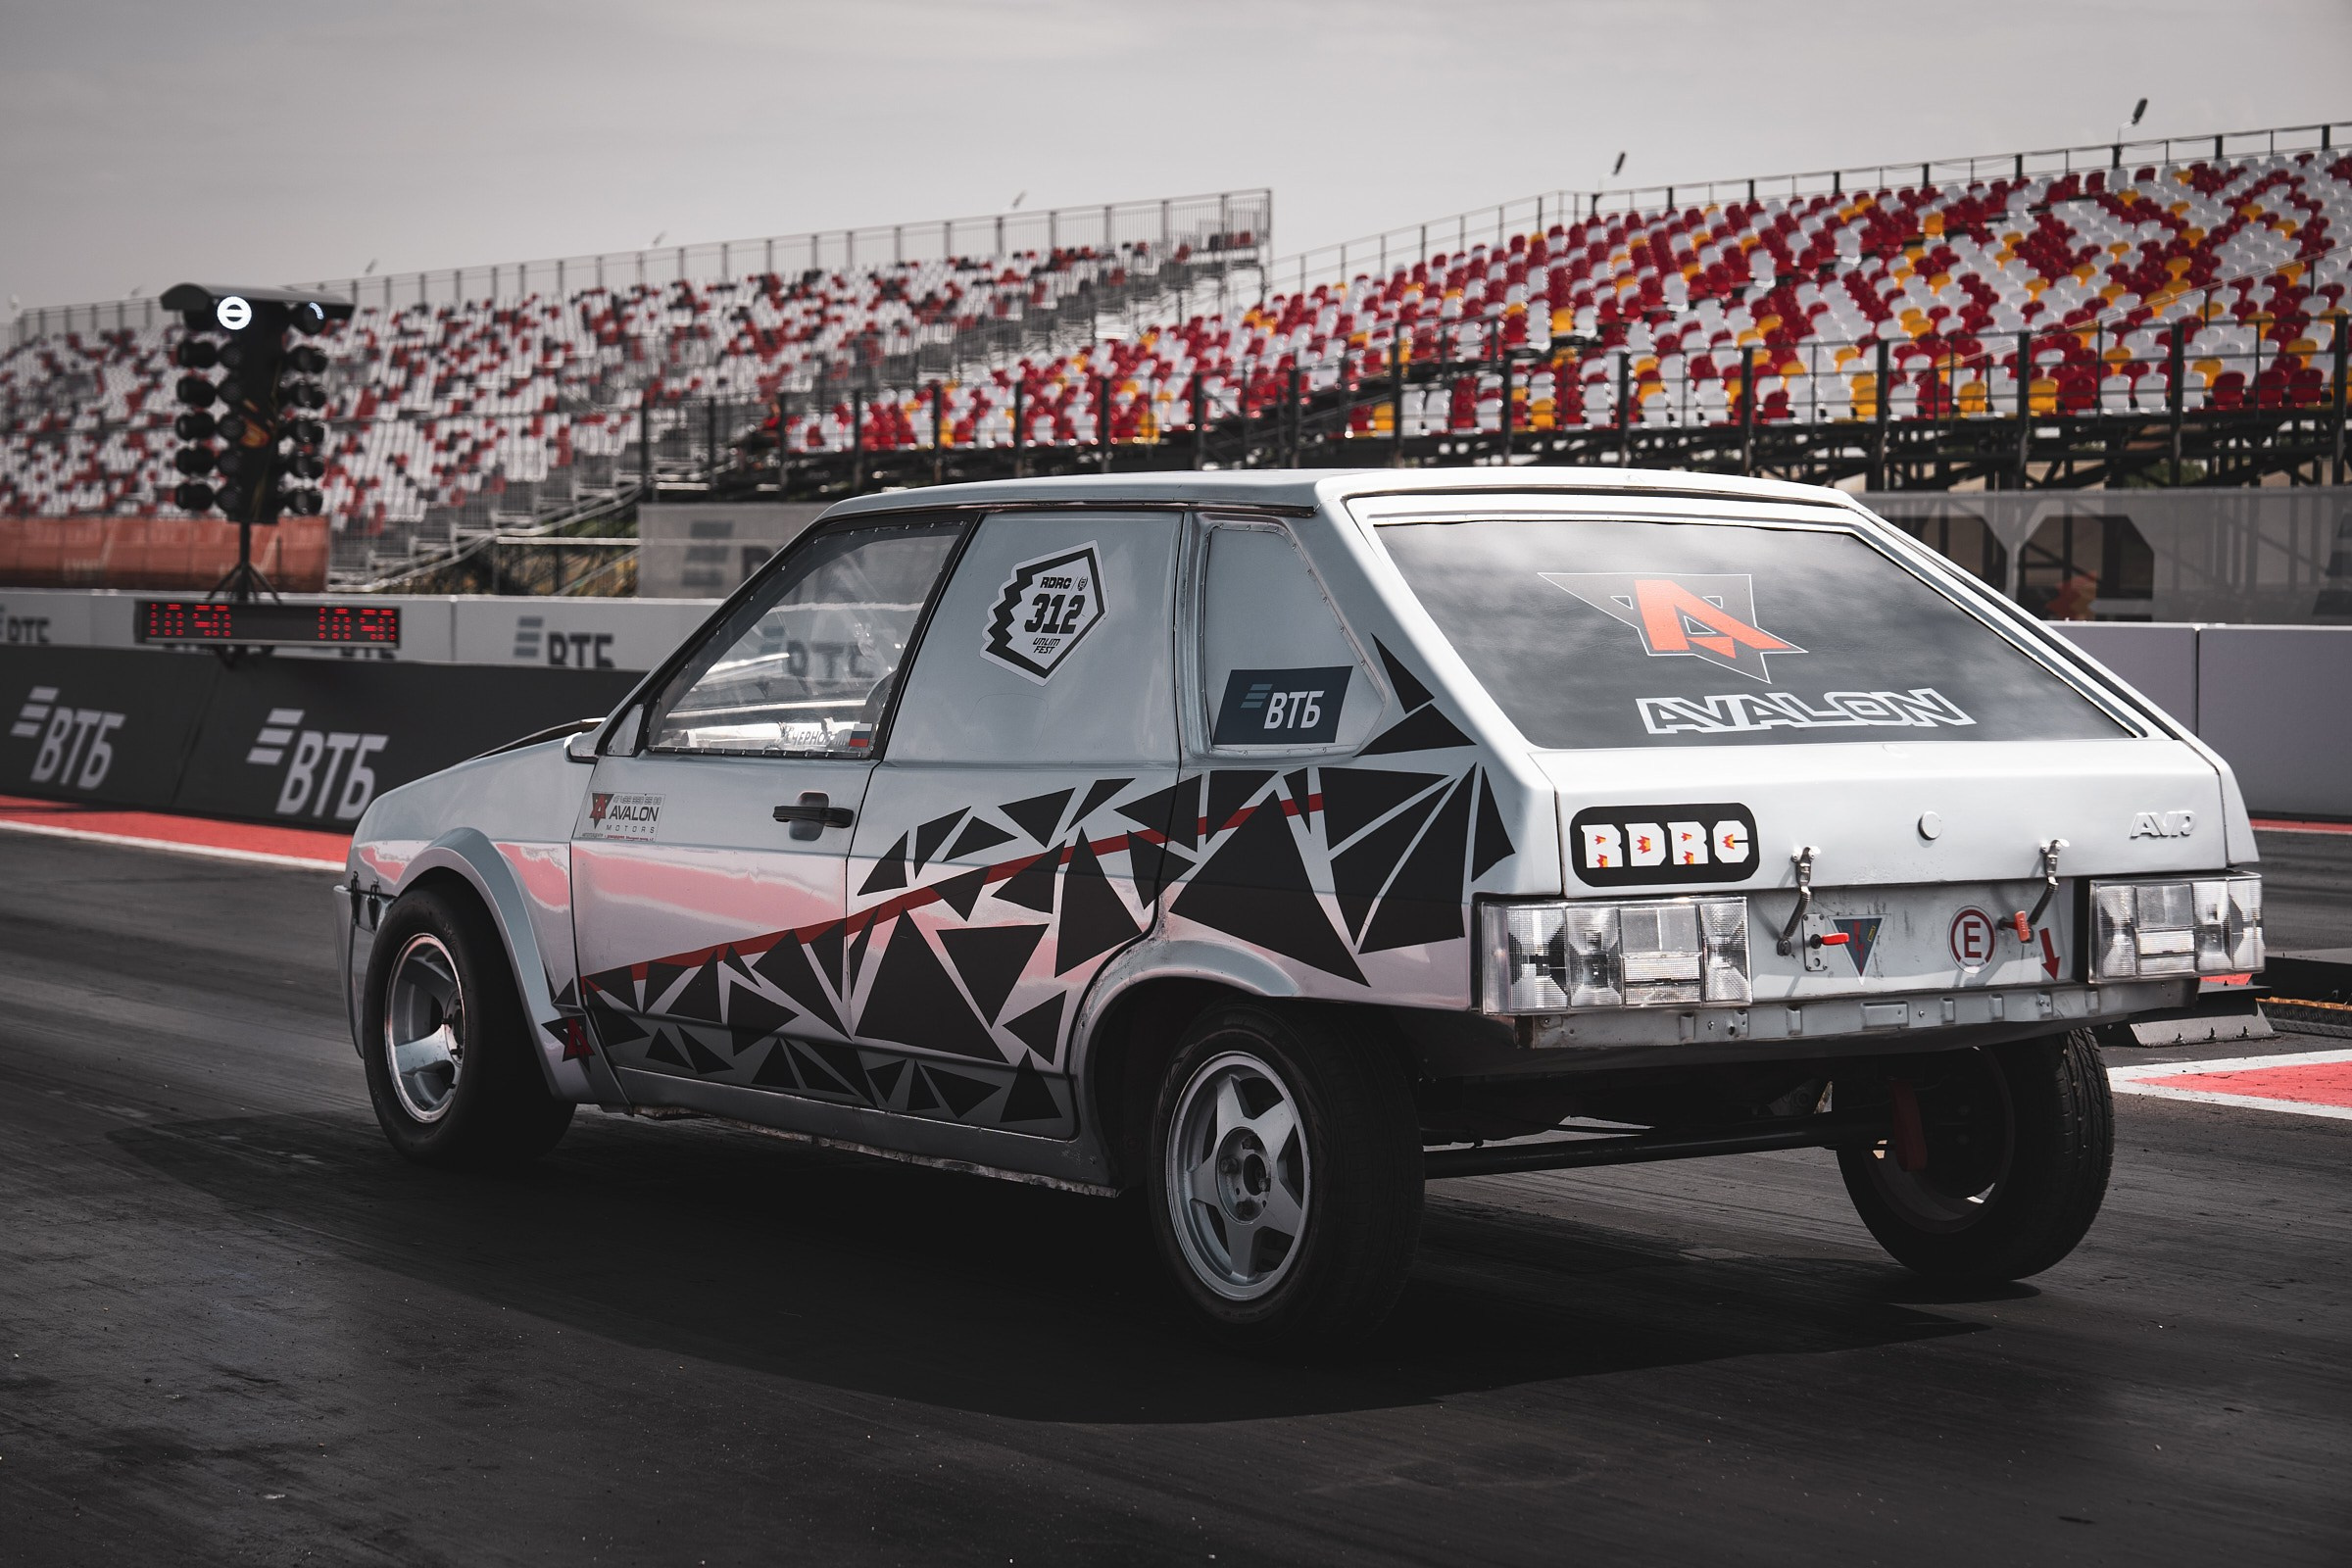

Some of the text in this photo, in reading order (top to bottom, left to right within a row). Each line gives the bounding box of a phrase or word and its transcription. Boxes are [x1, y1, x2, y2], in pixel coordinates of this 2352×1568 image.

[1040, 576, 1072, 589] RDRC
[1024, 593, 1085, 634] 312
[1034, 646, 1055, 655] FEST
[1263, 690, 1325, 729] ВТБ
[1636, 688, 1977, 734] AVALON
[31, 708, 124, 789] ВТБ
[275, 730, 388, 820] ВТБ
[606, 819, 655, 834] MOTORS
[609, 805, 660, 821] AVALON
[1581, 819, 1750, 869] RDRC
[1963, 921, 1983, 957] E
